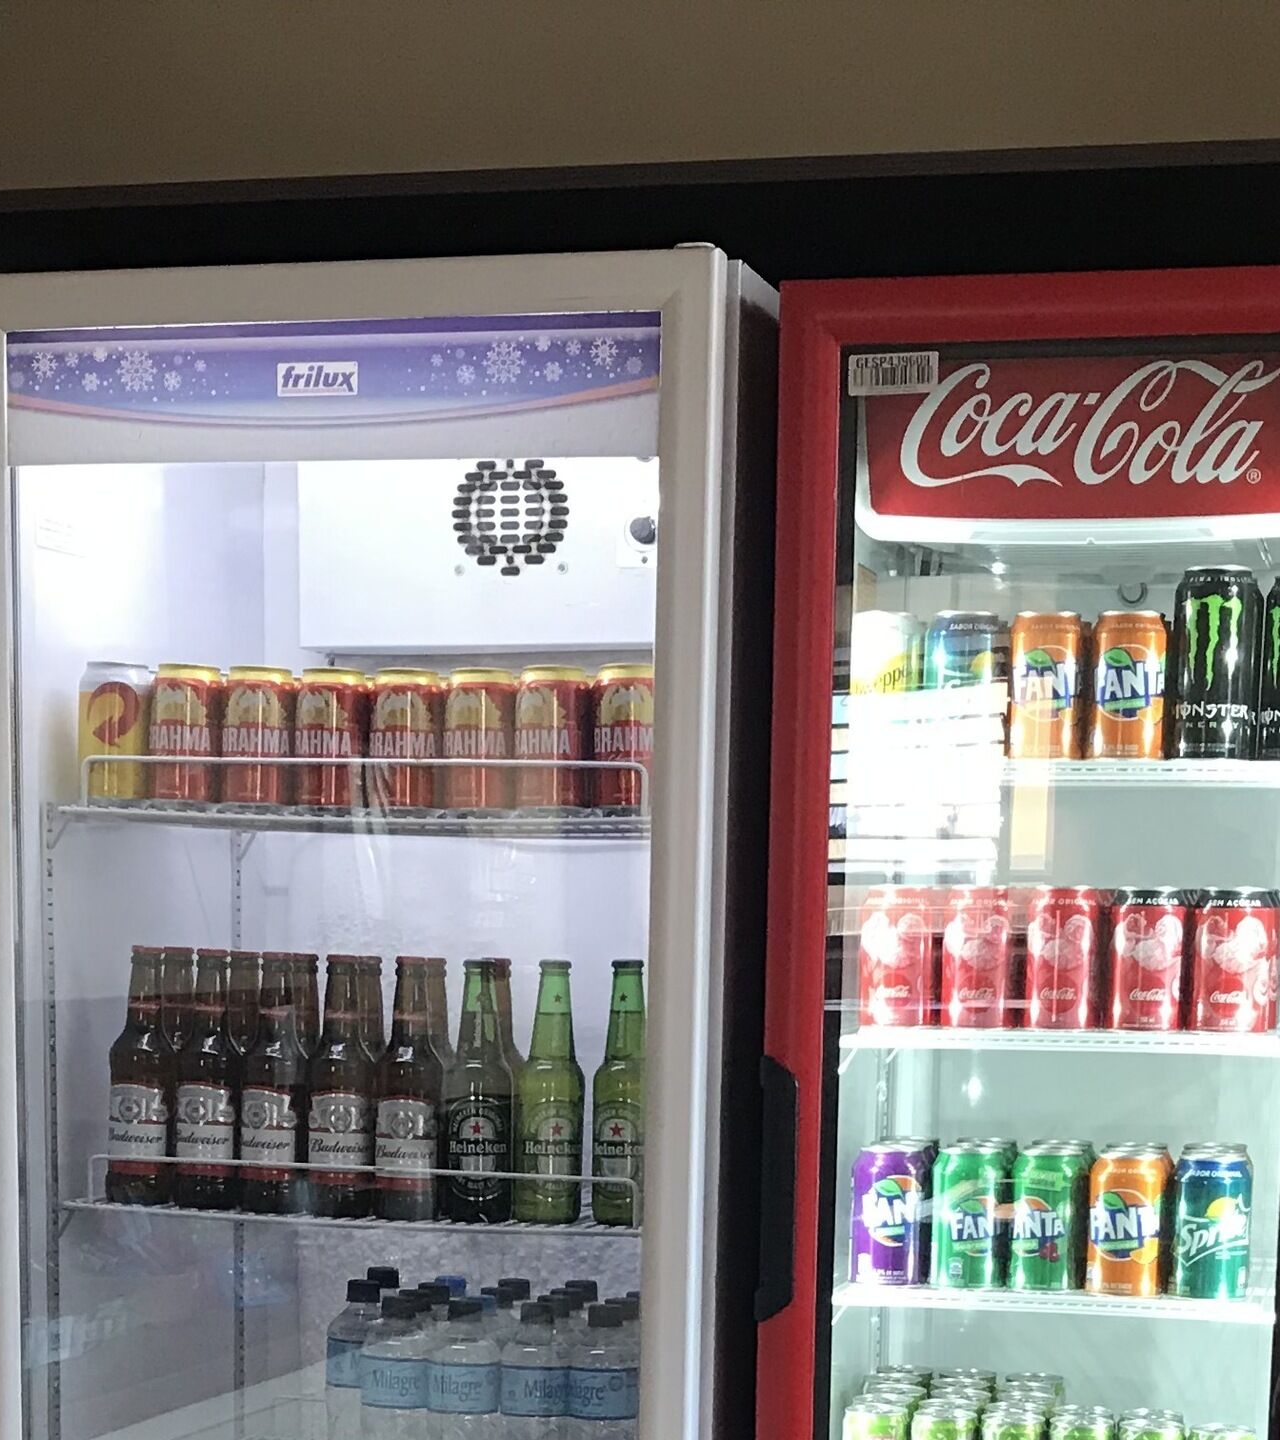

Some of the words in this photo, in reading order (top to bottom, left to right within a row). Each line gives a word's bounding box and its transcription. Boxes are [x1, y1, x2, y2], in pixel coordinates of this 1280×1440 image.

[280, 363, 356, 394] frilux
[1185, 721, 1239, 729] NERY
[594, 727, 654, 753] BRAHM
[241, 1131, 291, 1150] dweiser
[309, 1137, 369, 1154] Budweis
[449, 1140, 507, 1154] Heineken
[525, 1141, 576, 1155] Heinek
[594, 1142, 643, 1155] eineke
[862, 1189, 921, 1228] FAN
[949, 1210, 996, 1241] FAN
[1013, 1209, 1065, 1239] ANTA
[1090, 1202, 1160, 1241] FANT
[431, 1373, 482, 1400] Milagre
[523, 1379, 567, 1403] Milag
